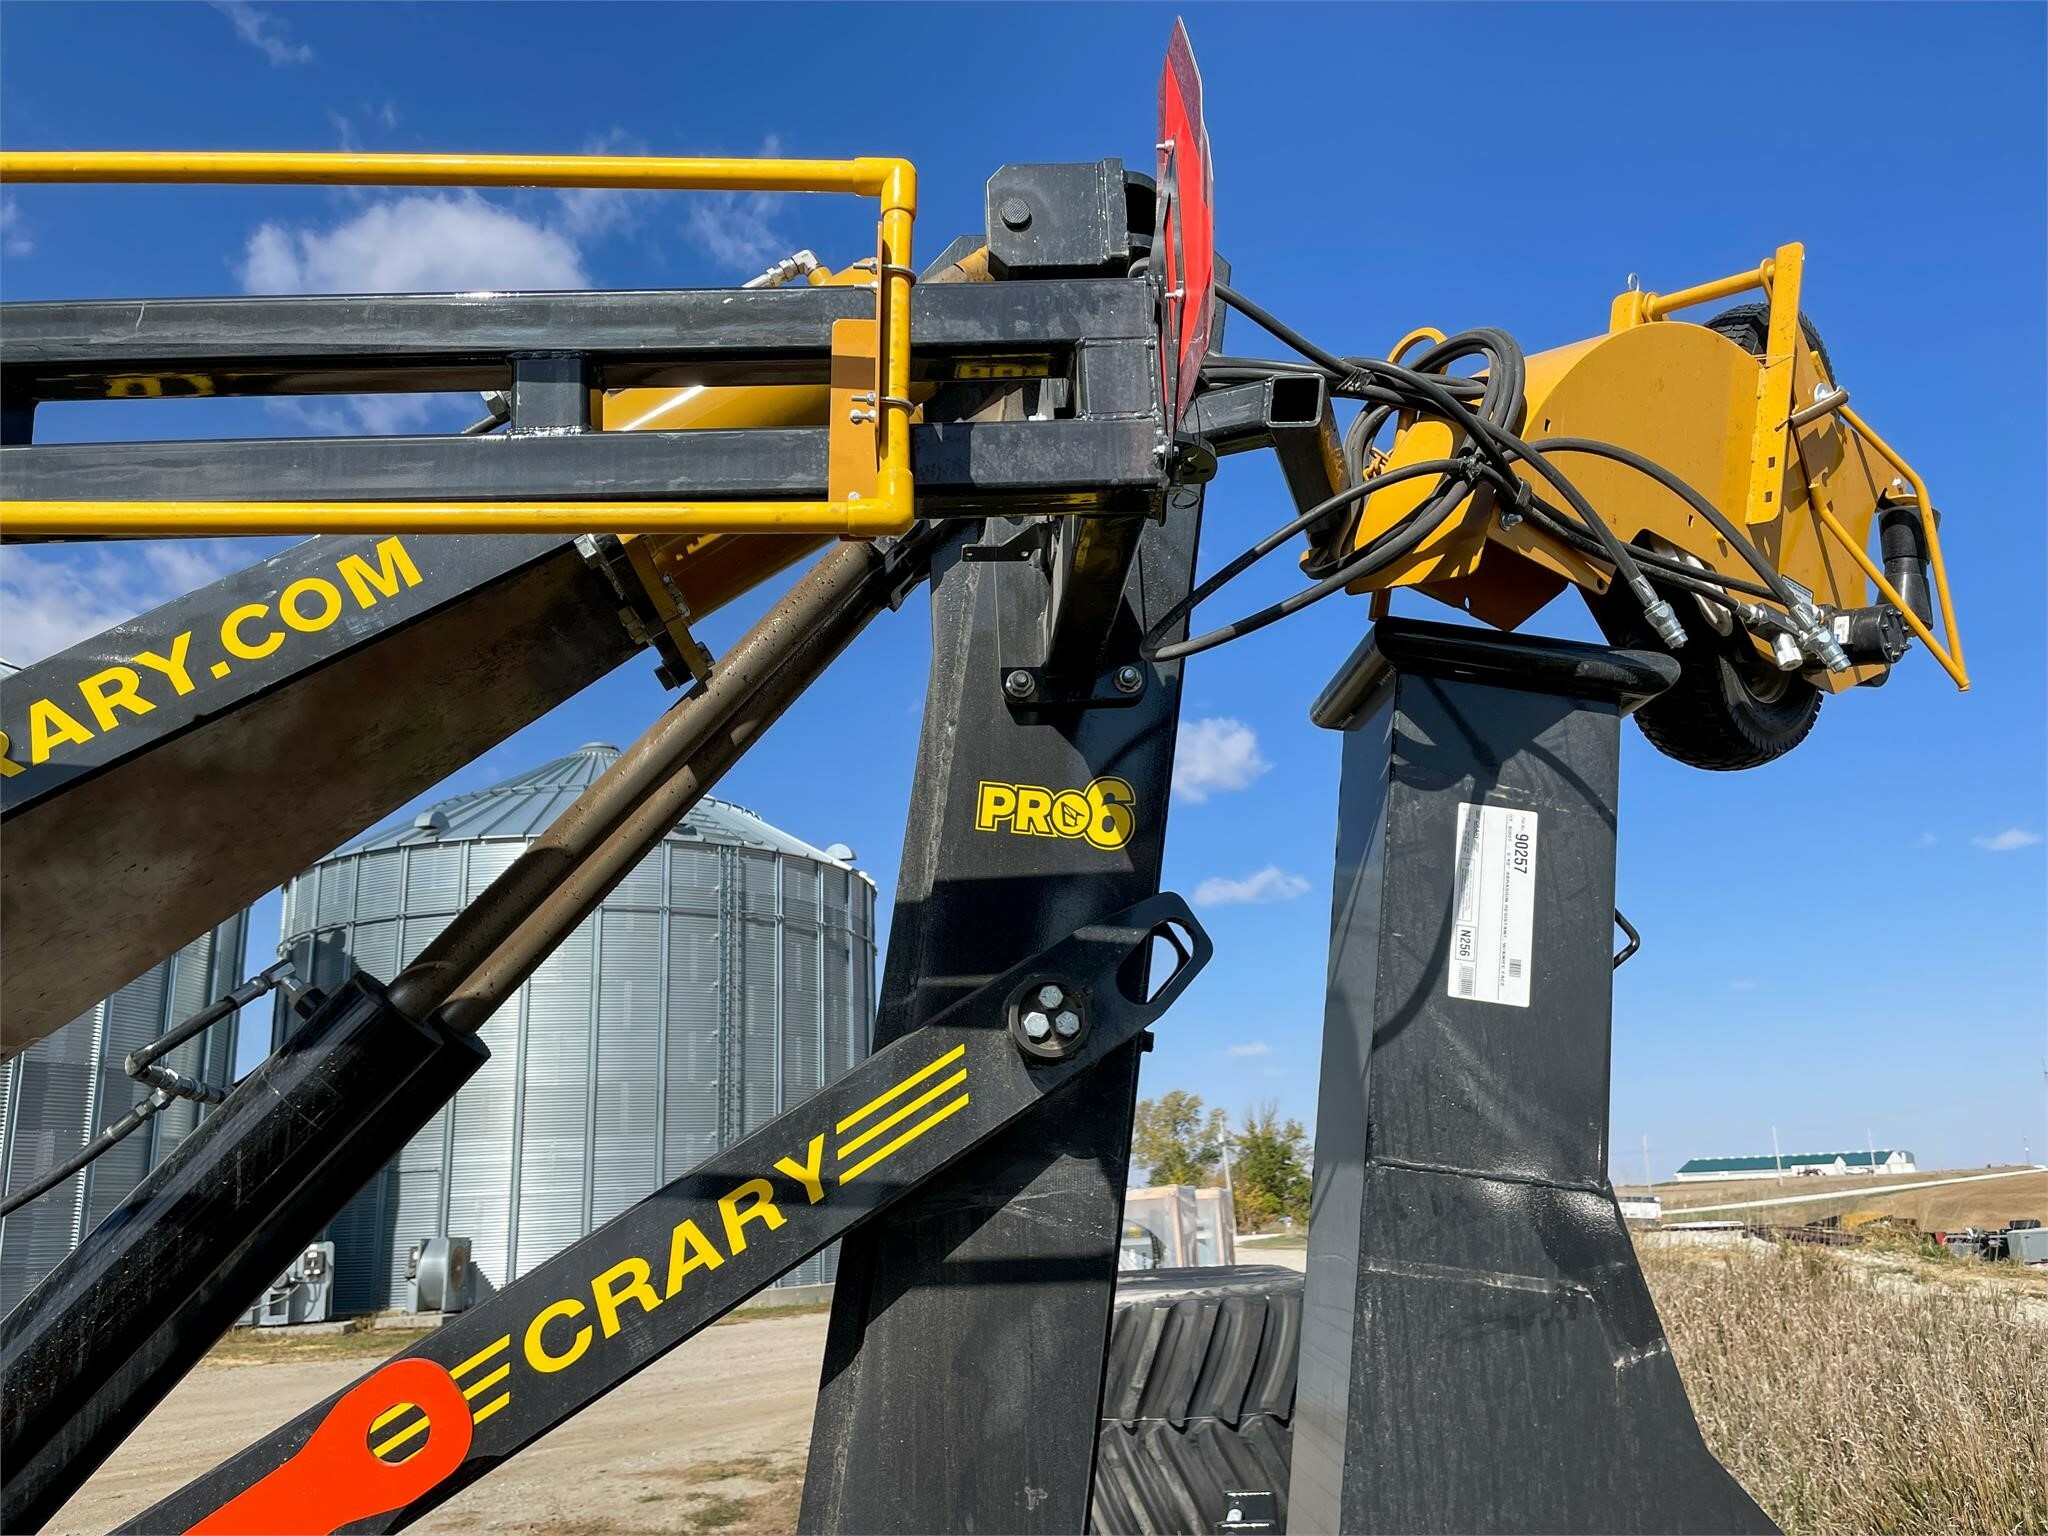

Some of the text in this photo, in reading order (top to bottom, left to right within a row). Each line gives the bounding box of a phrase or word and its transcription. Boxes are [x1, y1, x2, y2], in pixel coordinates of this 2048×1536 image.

[1513, 833, 1529, 874] 90257
[1459, 929, 1472, 957] N256
[523, 1132, 825, 1373] CRARY
